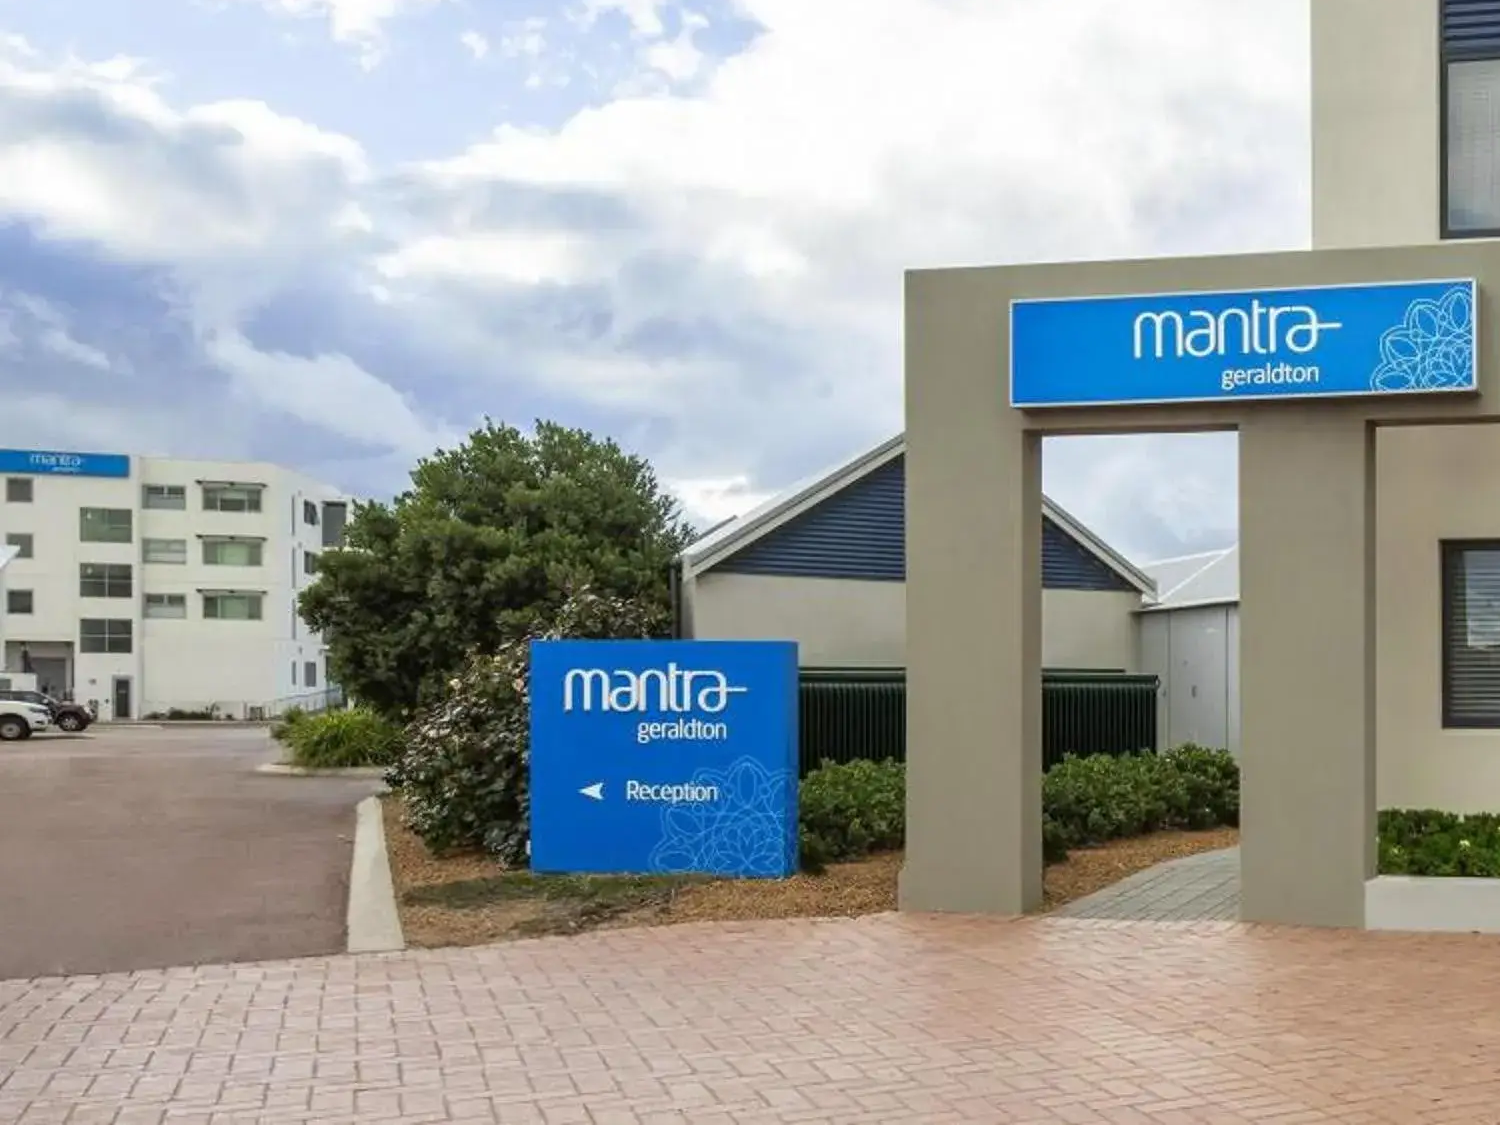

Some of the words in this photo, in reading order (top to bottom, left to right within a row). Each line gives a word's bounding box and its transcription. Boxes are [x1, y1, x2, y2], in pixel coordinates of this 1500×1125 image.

[1133, 299, 1342, 359] mantra
[1221, 362, 1320, 390] geraldton
[564, 662, 748, 713] mantra
[637, 718, 727, 744] geraldton
[626, 780, 719, 803] Reception
